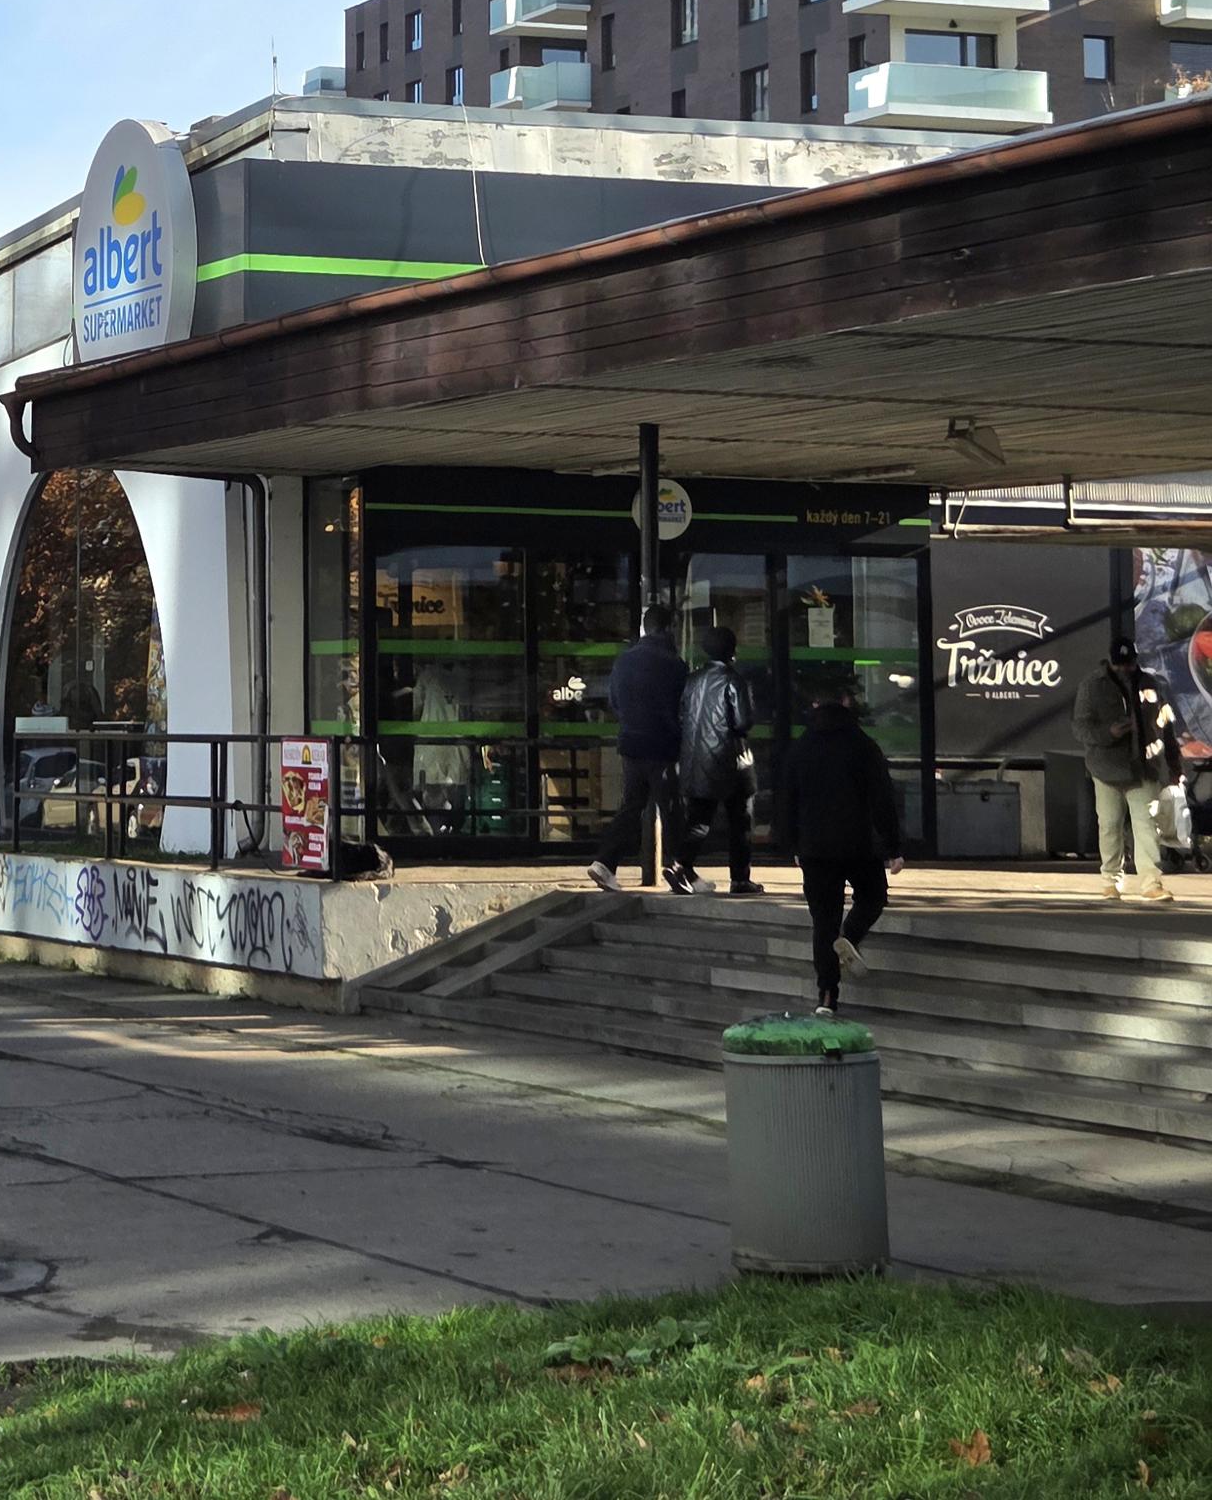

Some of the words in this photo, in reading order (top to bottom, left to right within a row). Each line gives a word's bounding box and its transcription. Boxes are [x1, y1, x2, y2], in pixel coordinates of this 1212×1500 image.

[83, 210, 163, 297] albert
[83, 295, 163, 344] SUPERMARKET
[658, 499, 686, 513] bert
[965, 613, 995, 628] Ovoce
[936, 637, 1062, 687] Tržnice
